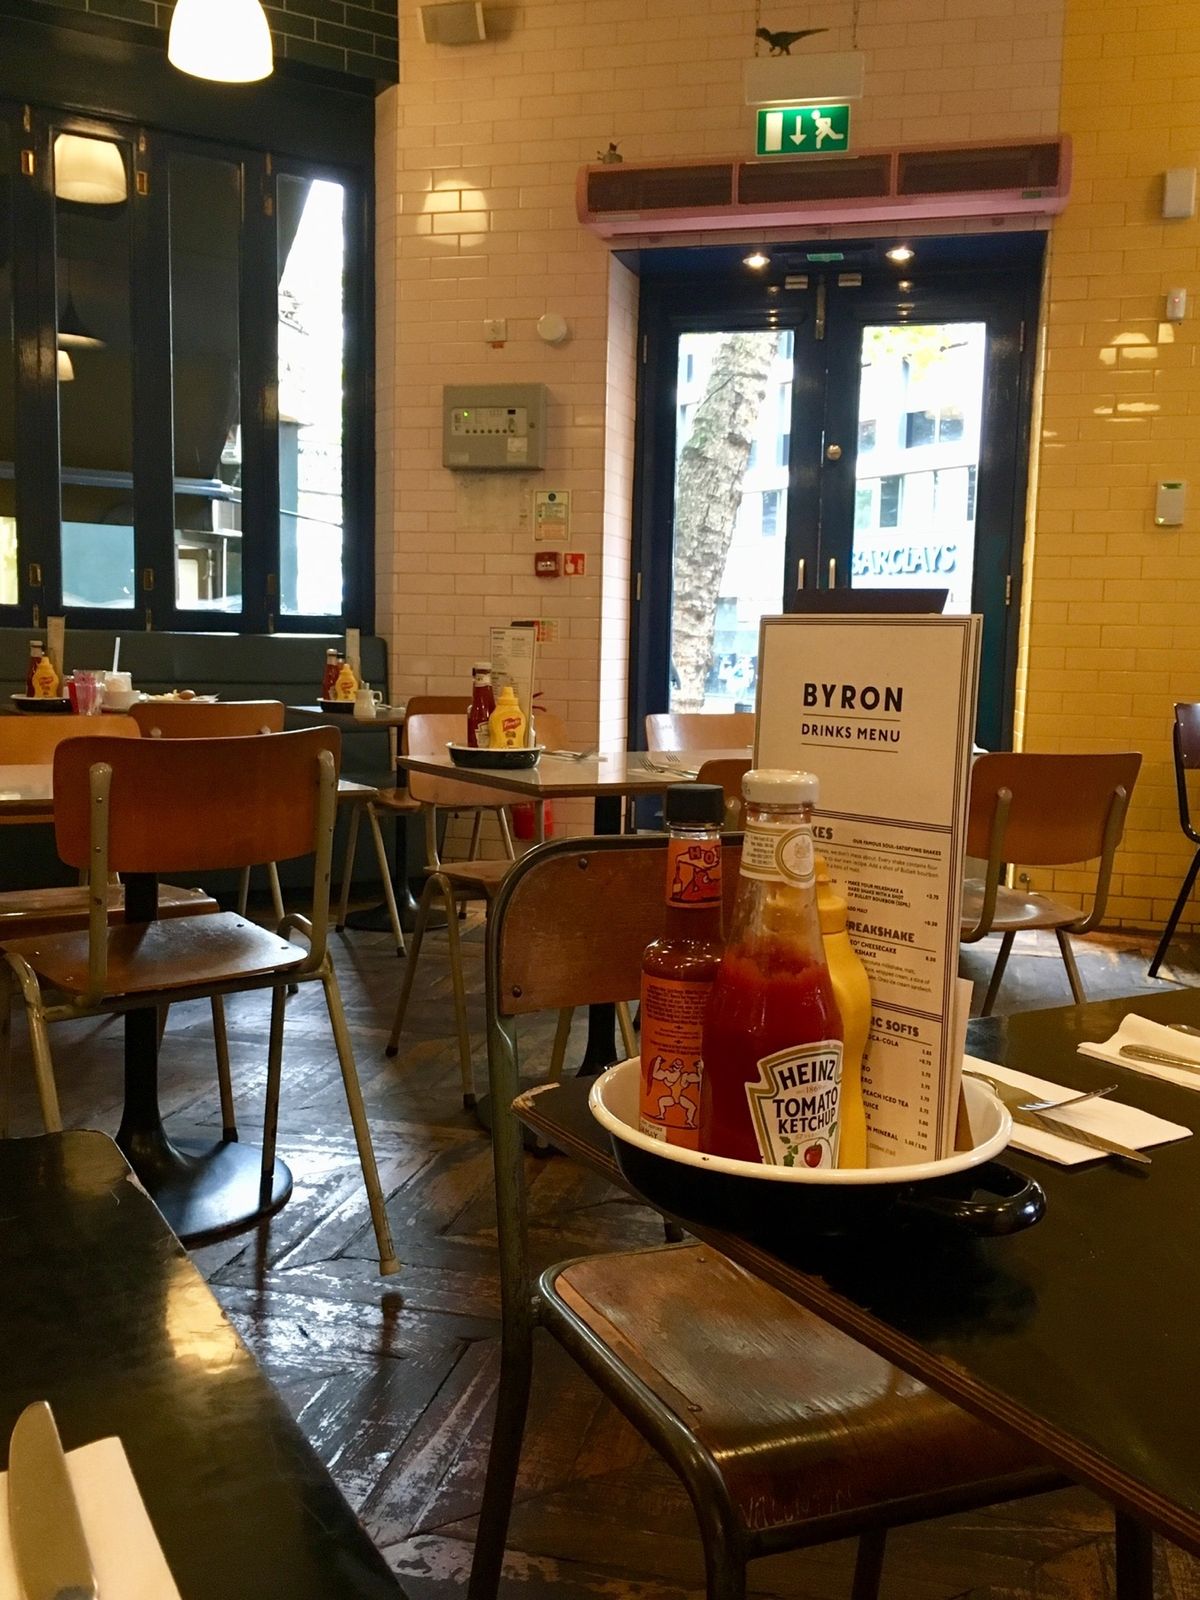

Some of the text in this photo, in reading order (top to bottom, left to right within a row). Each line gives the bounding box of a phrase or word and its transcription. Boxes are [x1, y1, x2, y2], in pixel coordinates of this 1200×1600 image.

[803, 682, 904, 712] BYRON
[801, 722, 901, 742] DRINKS MENU
[861, 941, 897, 954] CHEESECAKE
[885, 1020, 920, 1037] SOFTS
[778, 1059, 836, 1091] HEINZ
[772, 1086, 838, 1118] TOMATO
[862, 1089, 909, 1108] PEACH ICED TEA
[778, 1109, 836, 1134] KETCHUP
[873, 1127, 898, 1141] MINERAL
